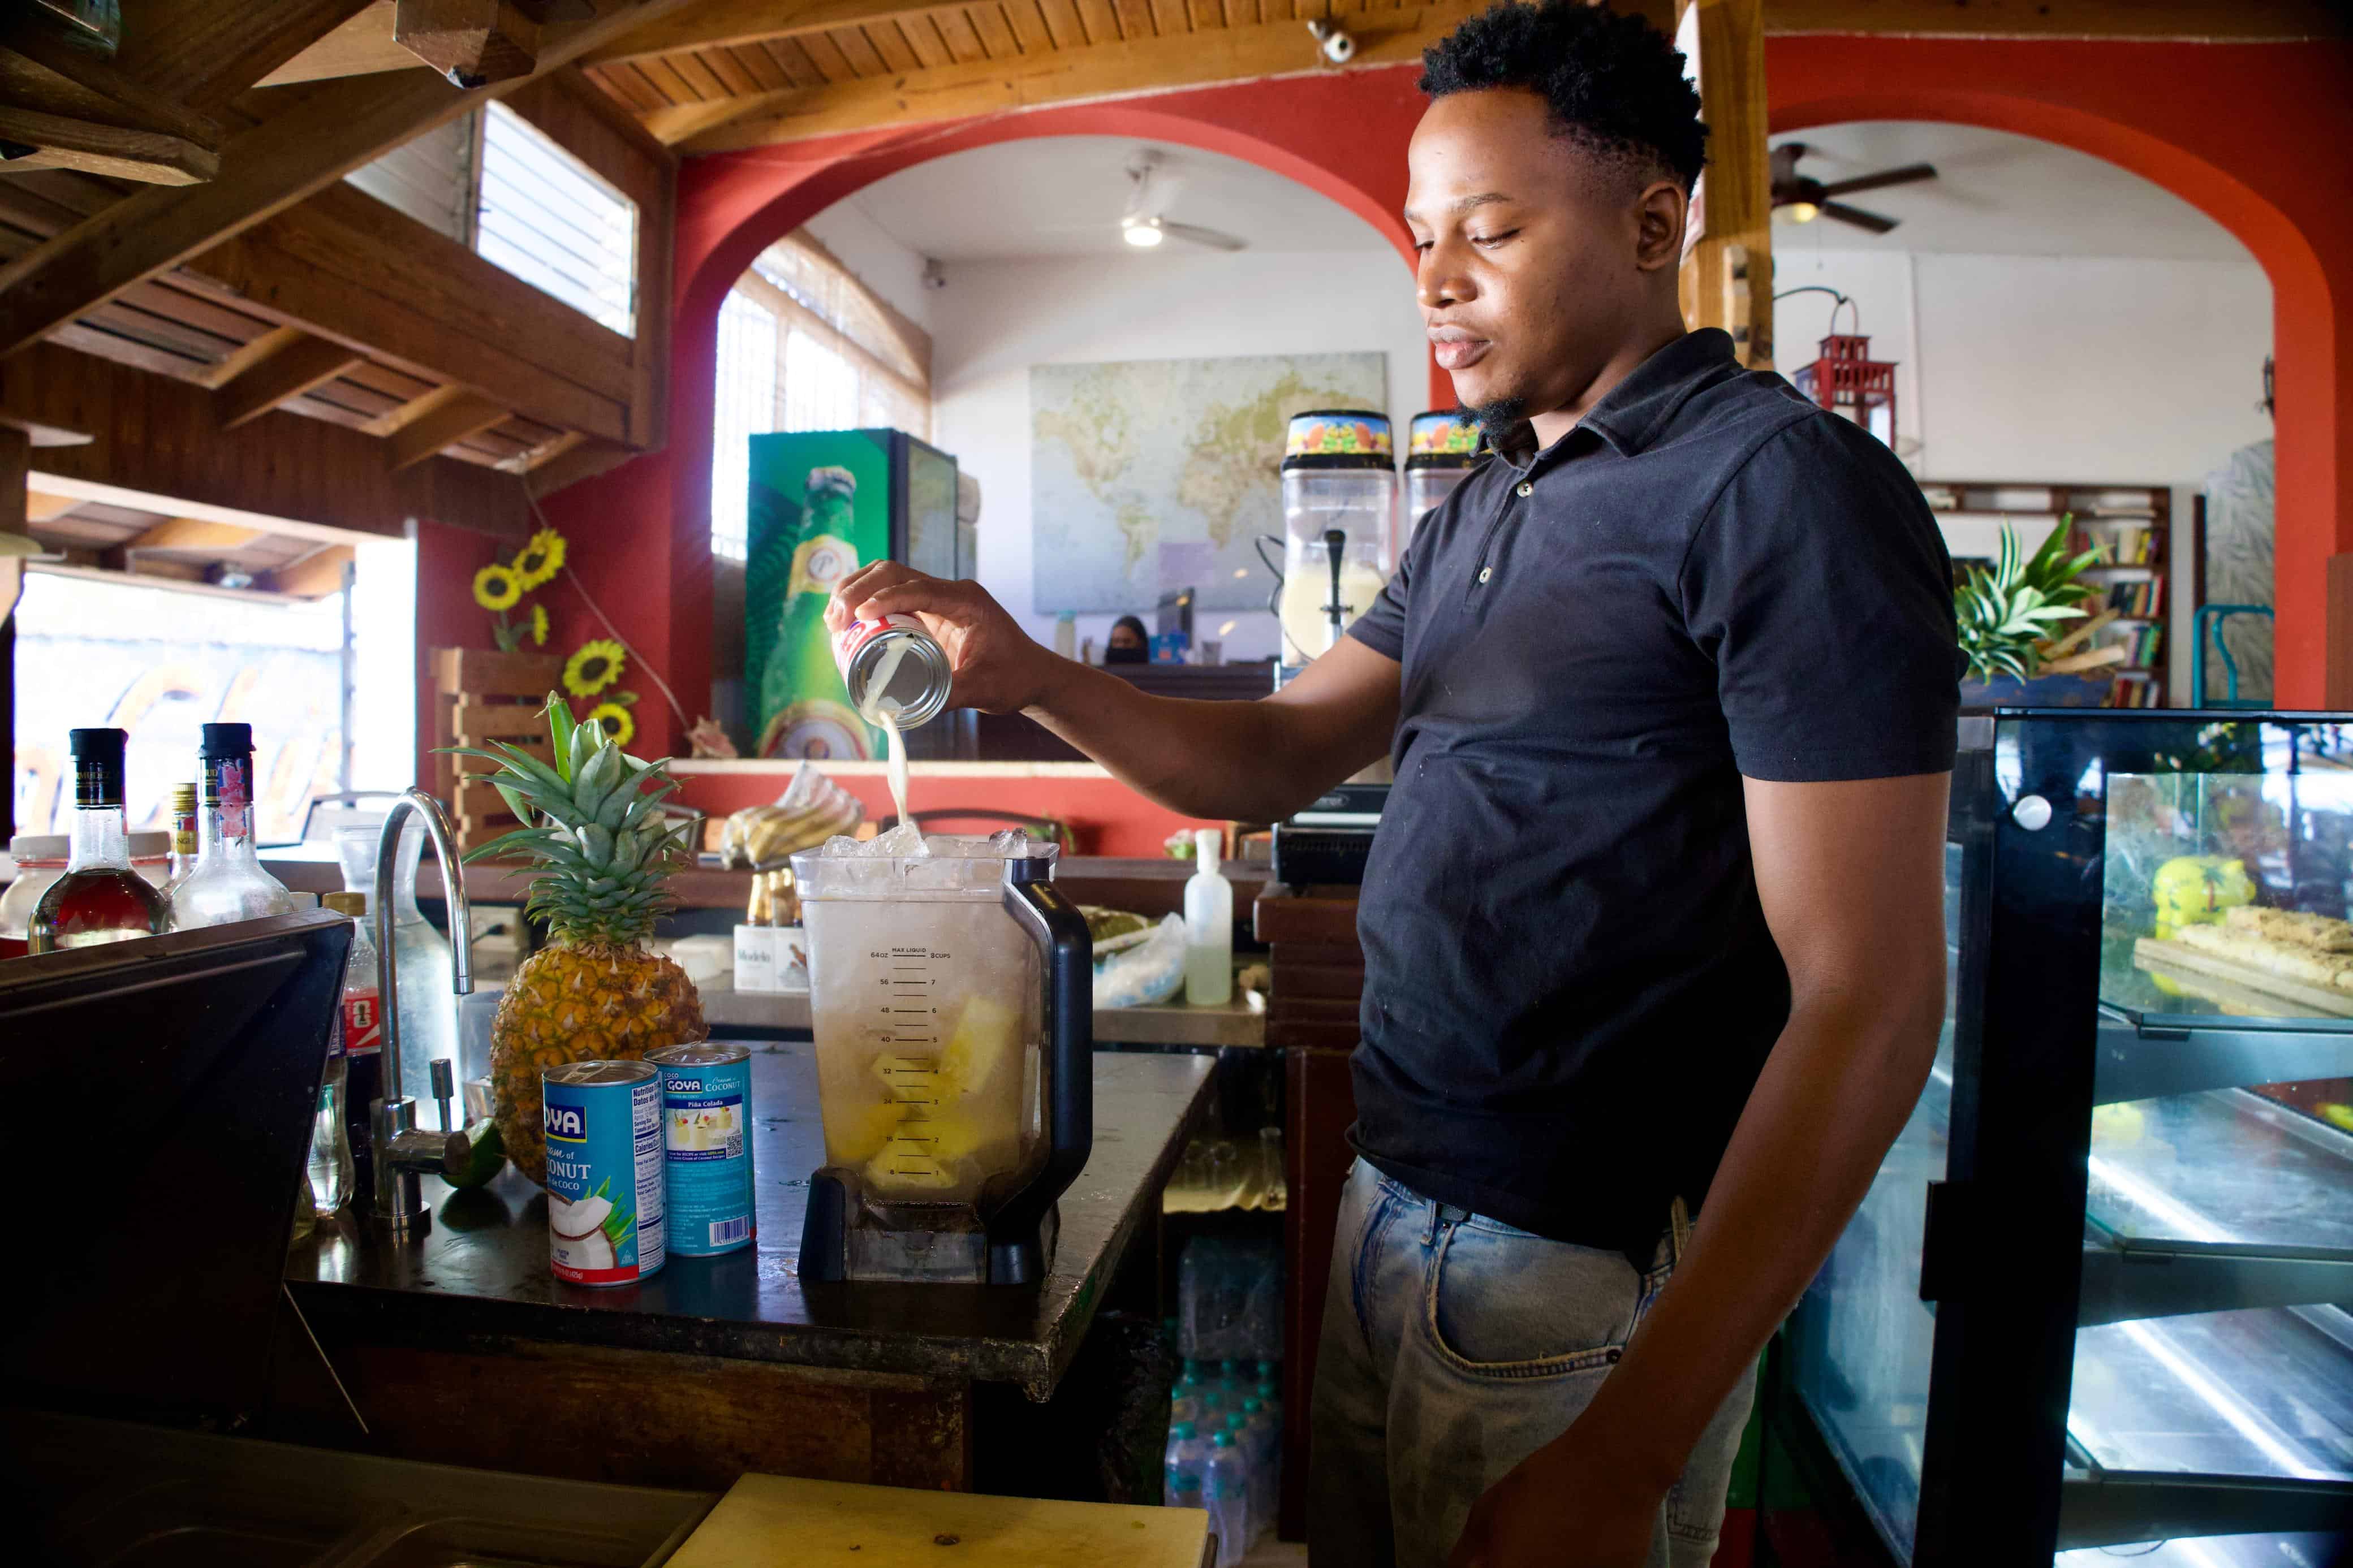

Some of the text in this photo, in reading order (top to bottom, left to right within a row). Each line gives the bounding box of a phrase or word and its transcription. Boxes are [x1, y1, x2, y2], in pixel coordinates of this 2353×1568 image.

[667, 1081, 700, 1091] GOYA
[705, 1081, 742, 1092] COCONUT
[634, 1097, 648, 1106] Datos
[558, 1181, 580, 1190] COCO
